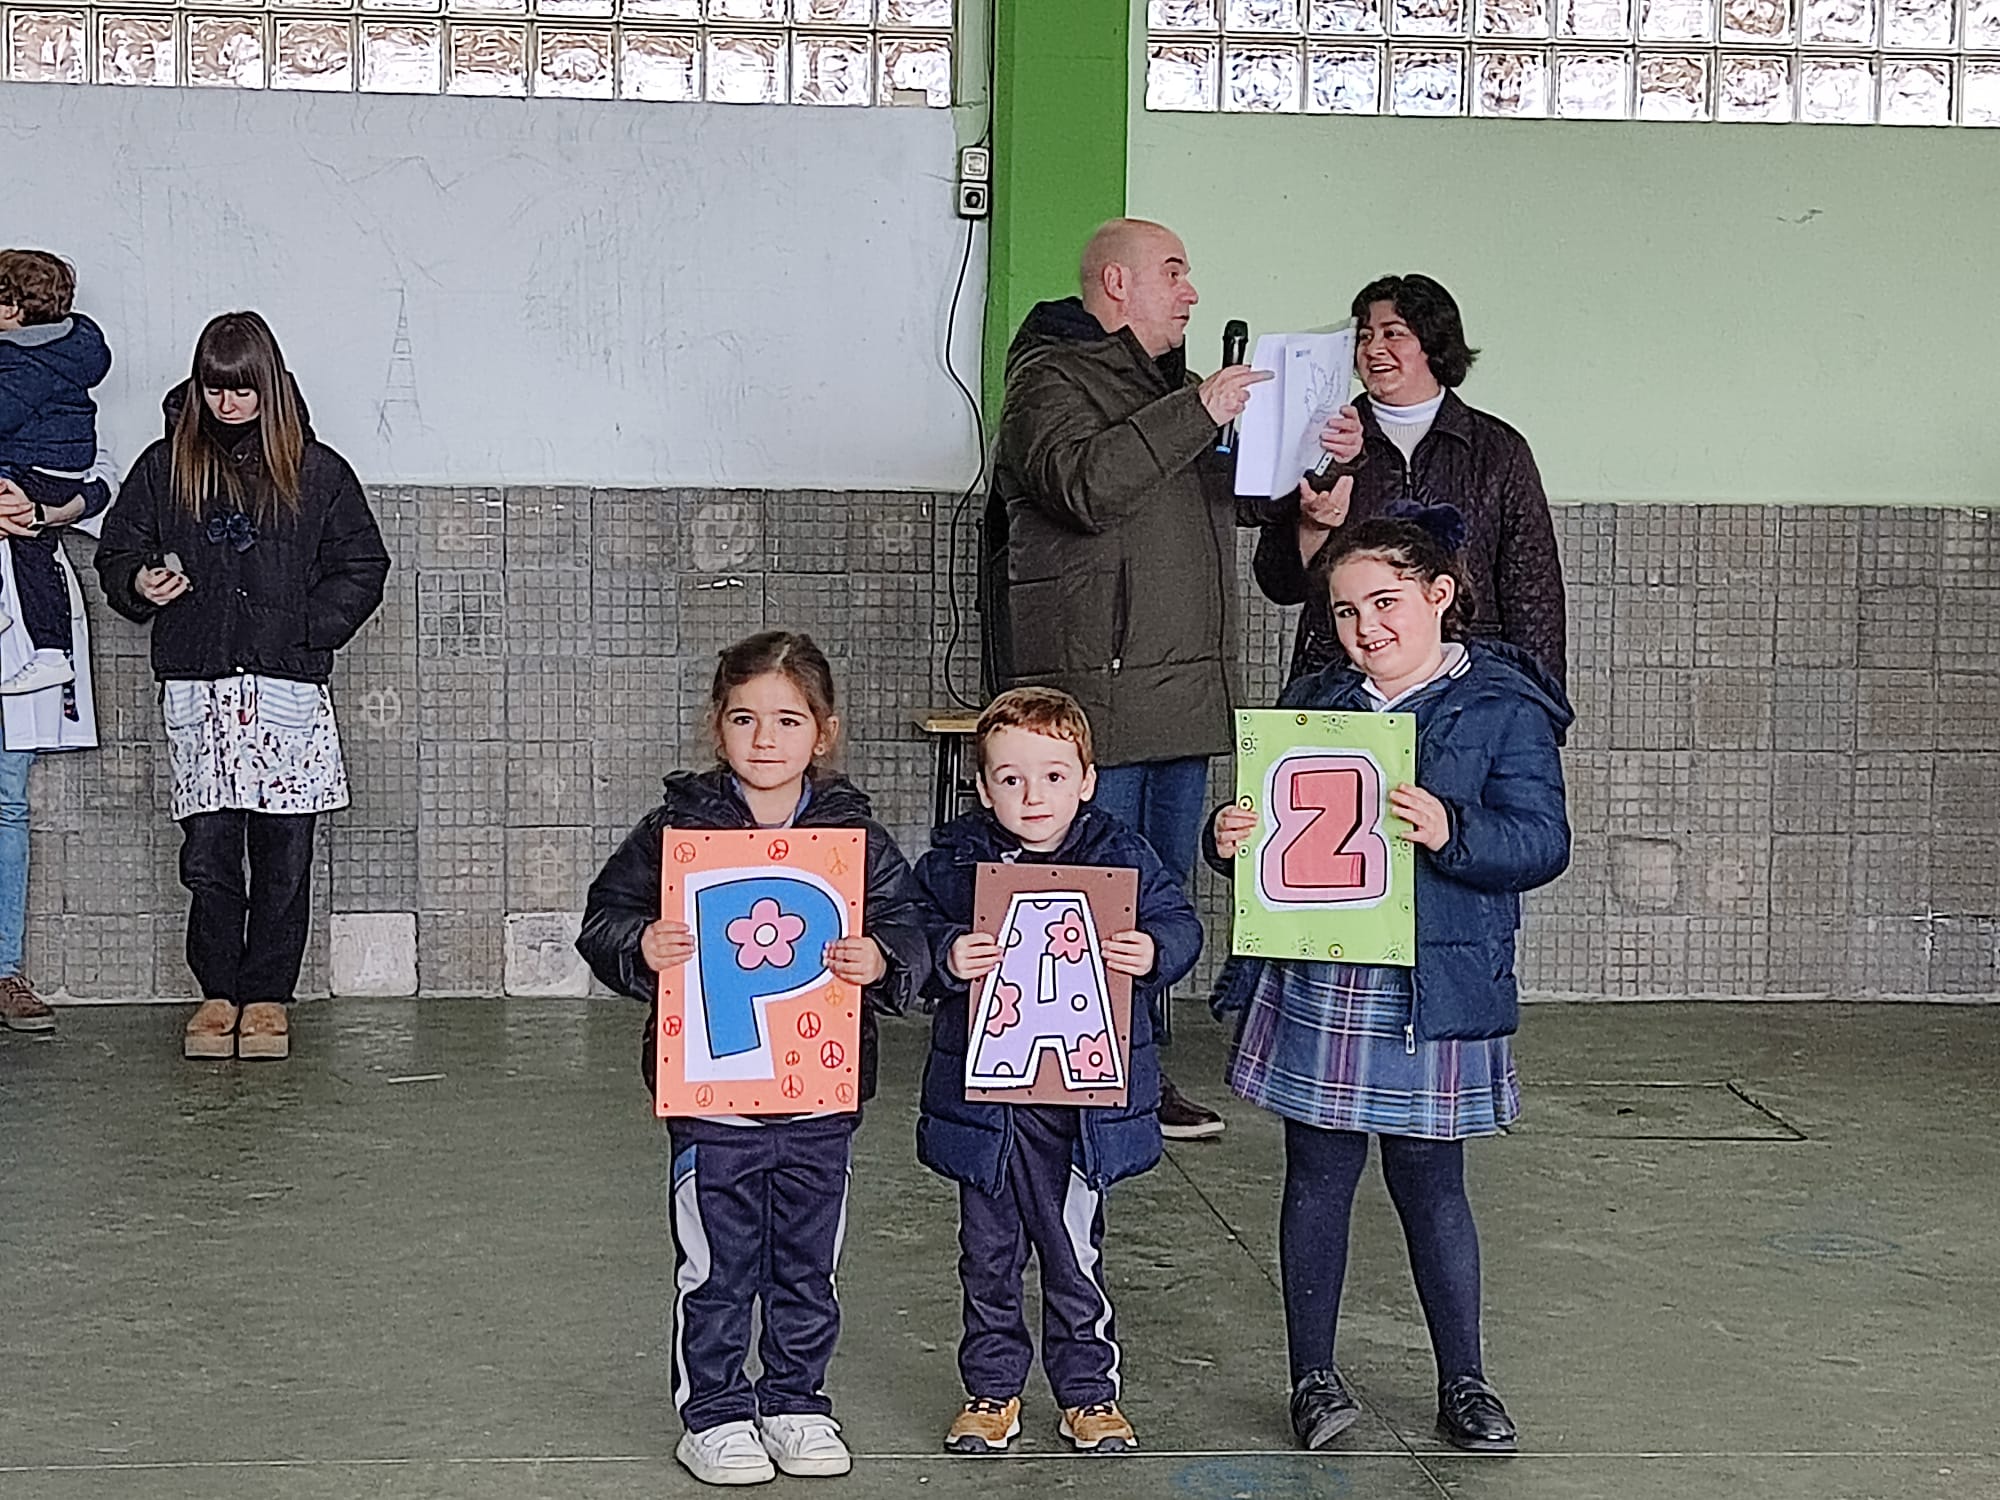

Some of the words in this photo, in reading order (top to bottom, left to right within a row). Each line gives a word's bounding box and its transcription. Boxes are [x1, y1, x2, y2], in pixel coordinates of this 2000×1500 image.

[1279, 766, 1367, 889] Z
[695, 876, 843, 1060] P
[965, 890, 1126, 1090] A
